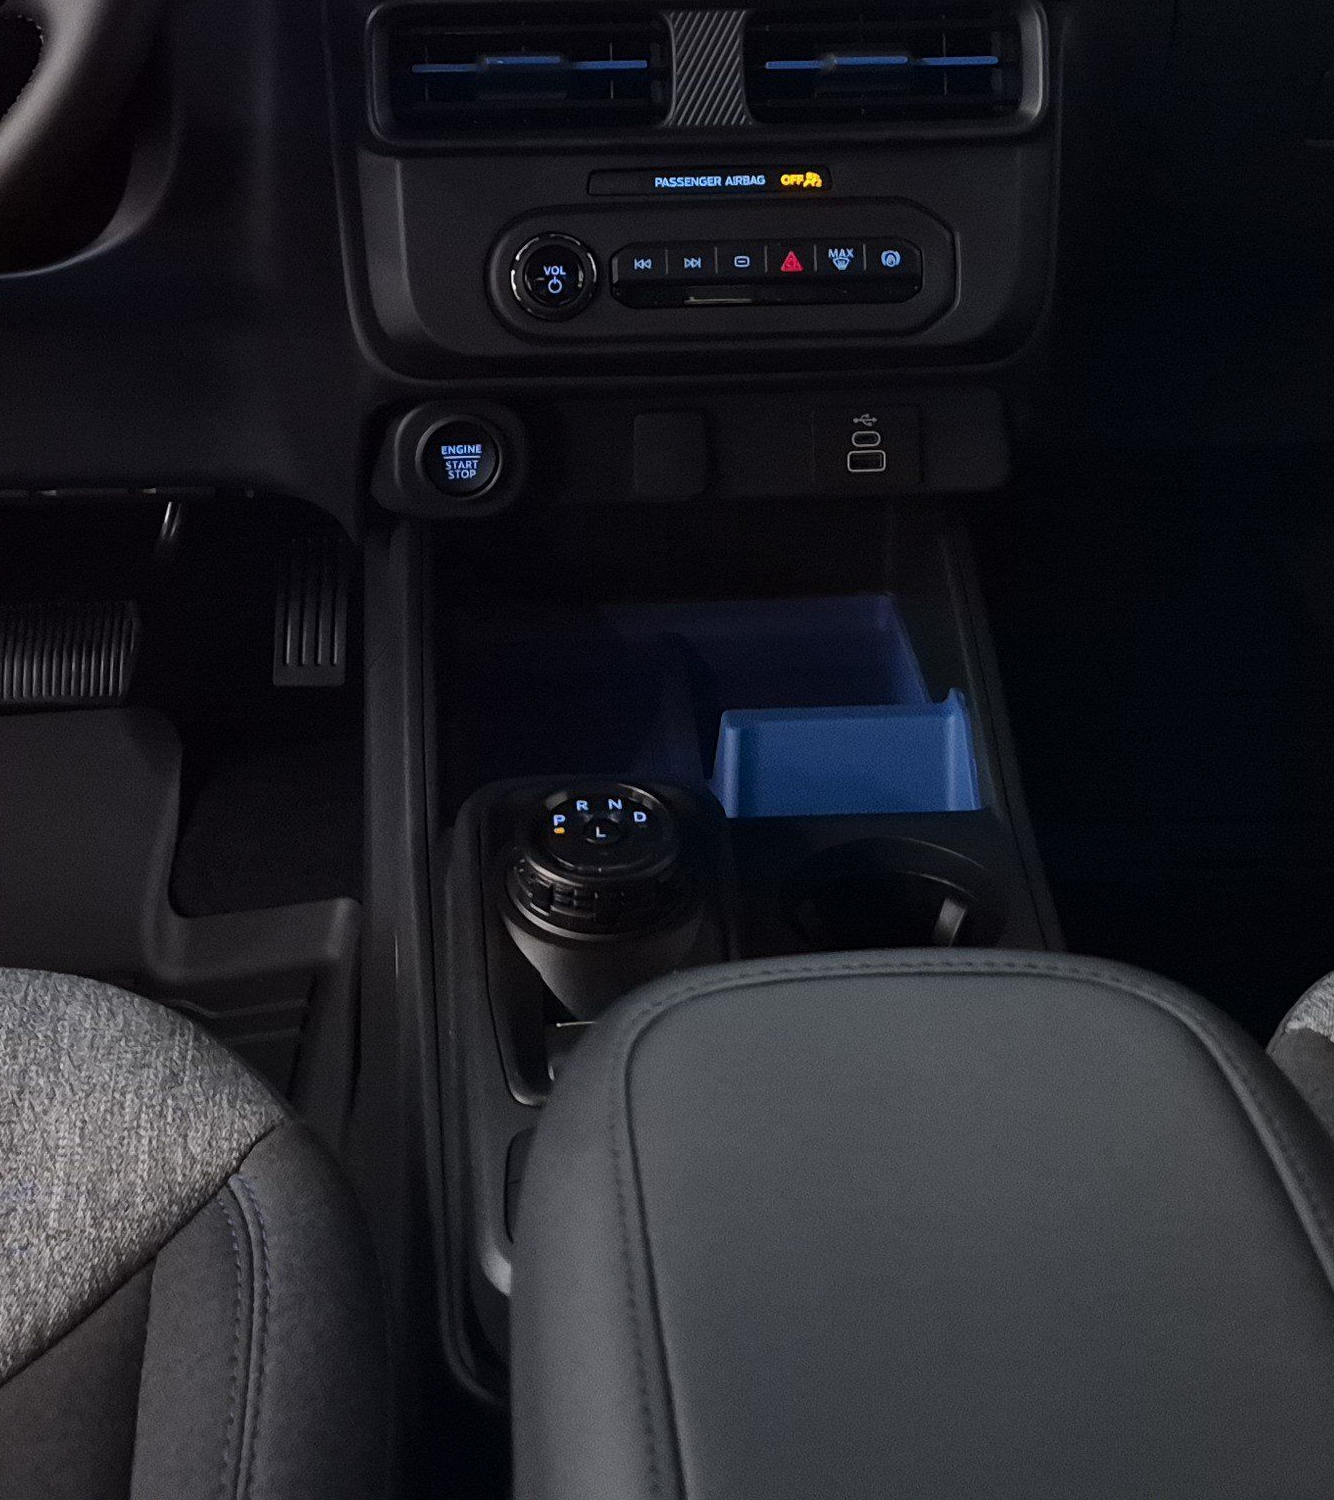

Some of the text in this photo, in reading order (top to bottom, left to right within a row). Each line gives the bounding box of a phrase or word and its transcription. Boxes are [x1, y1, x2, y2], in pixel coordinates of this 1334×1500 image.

[654, 174, 804, 188] PASSENGER AIRBAG OFF
[828, 248, 854, 259] MAX
[543, 265, 566, 276] VOL
[441, 444, 482, 455] ENGINE
[445, 460, 479, 470] START
[448, 469, 477, 480] STOP
[553, 798, 647, 827] P R N D
[595, 826, 606, 838] L
